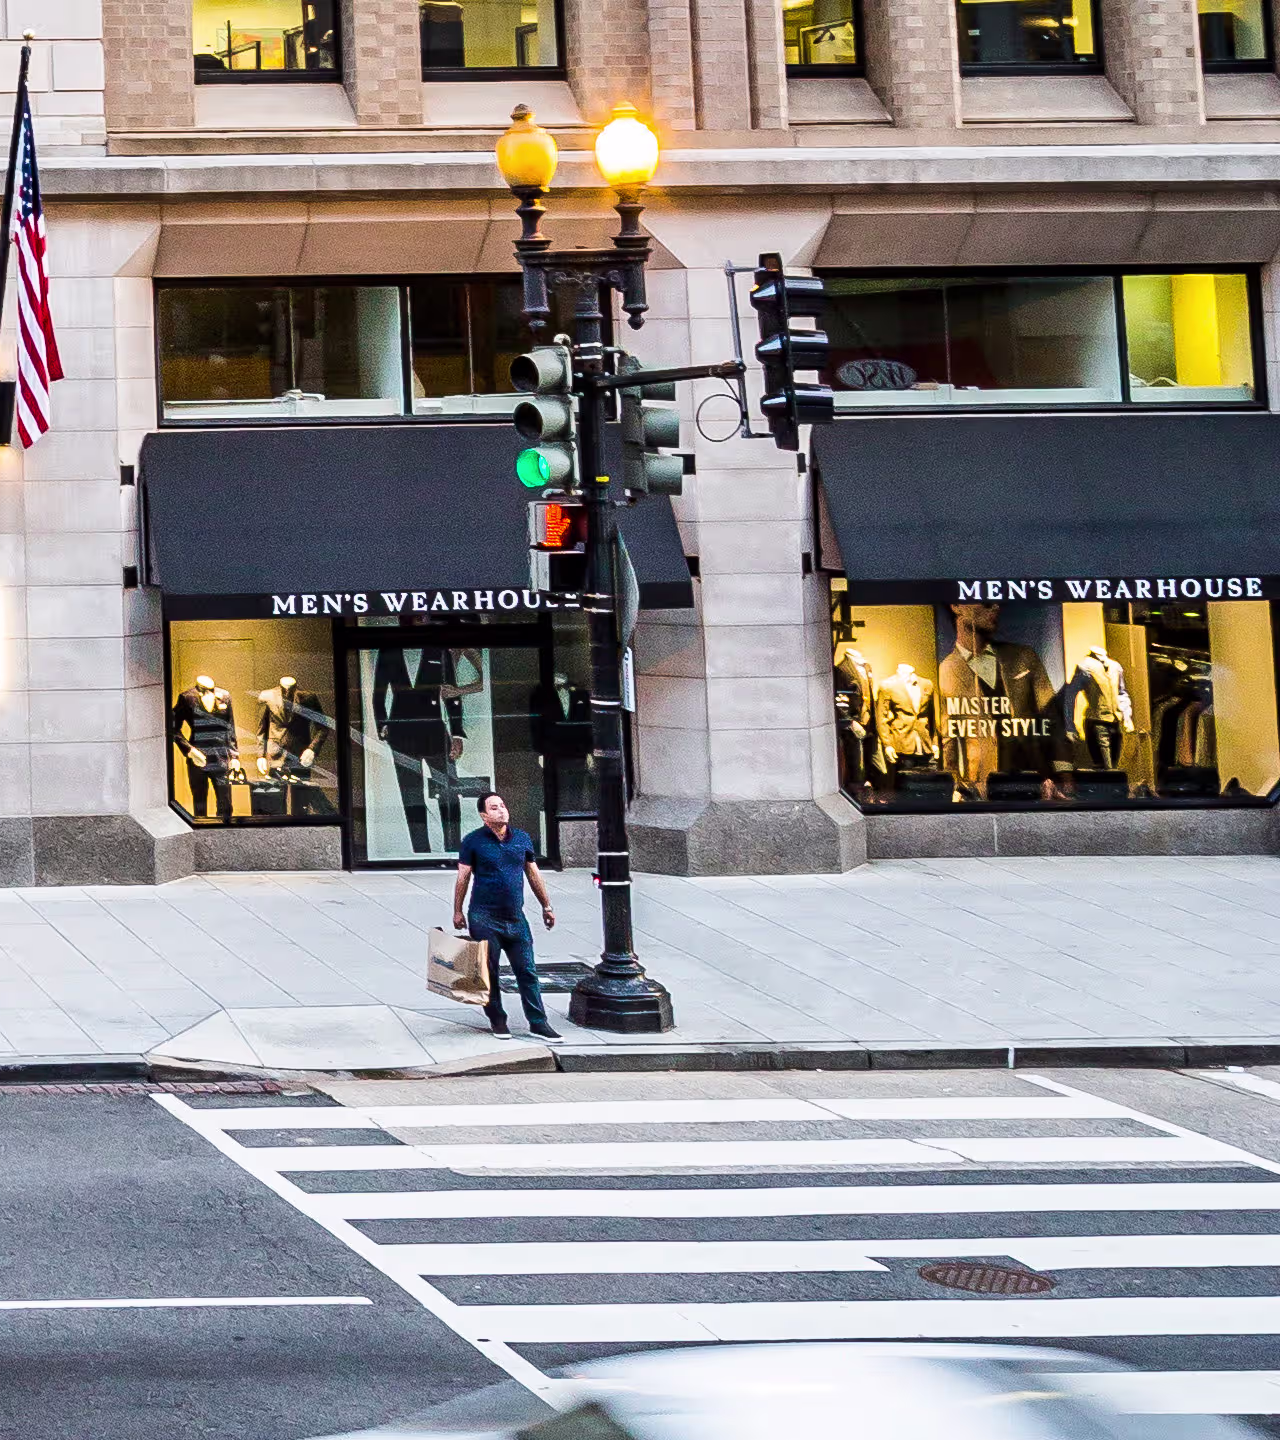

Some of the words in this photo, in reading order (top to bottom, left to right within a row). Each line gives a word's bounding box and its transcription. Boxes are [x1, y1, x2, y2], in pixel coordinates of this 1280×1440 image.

[957, 580, 1053, 600] MEN'S
[1064, 577, 1263, 599] WEARHOUSE
[272, 593, 369, 615] MEN'S
[381, 589, 581, 613] WEARHOU
[946, 696, 1011, 715] MASTER
[947, 719, 997, 738] EVERY
[1001, 718, 1051, 738] STYLE
